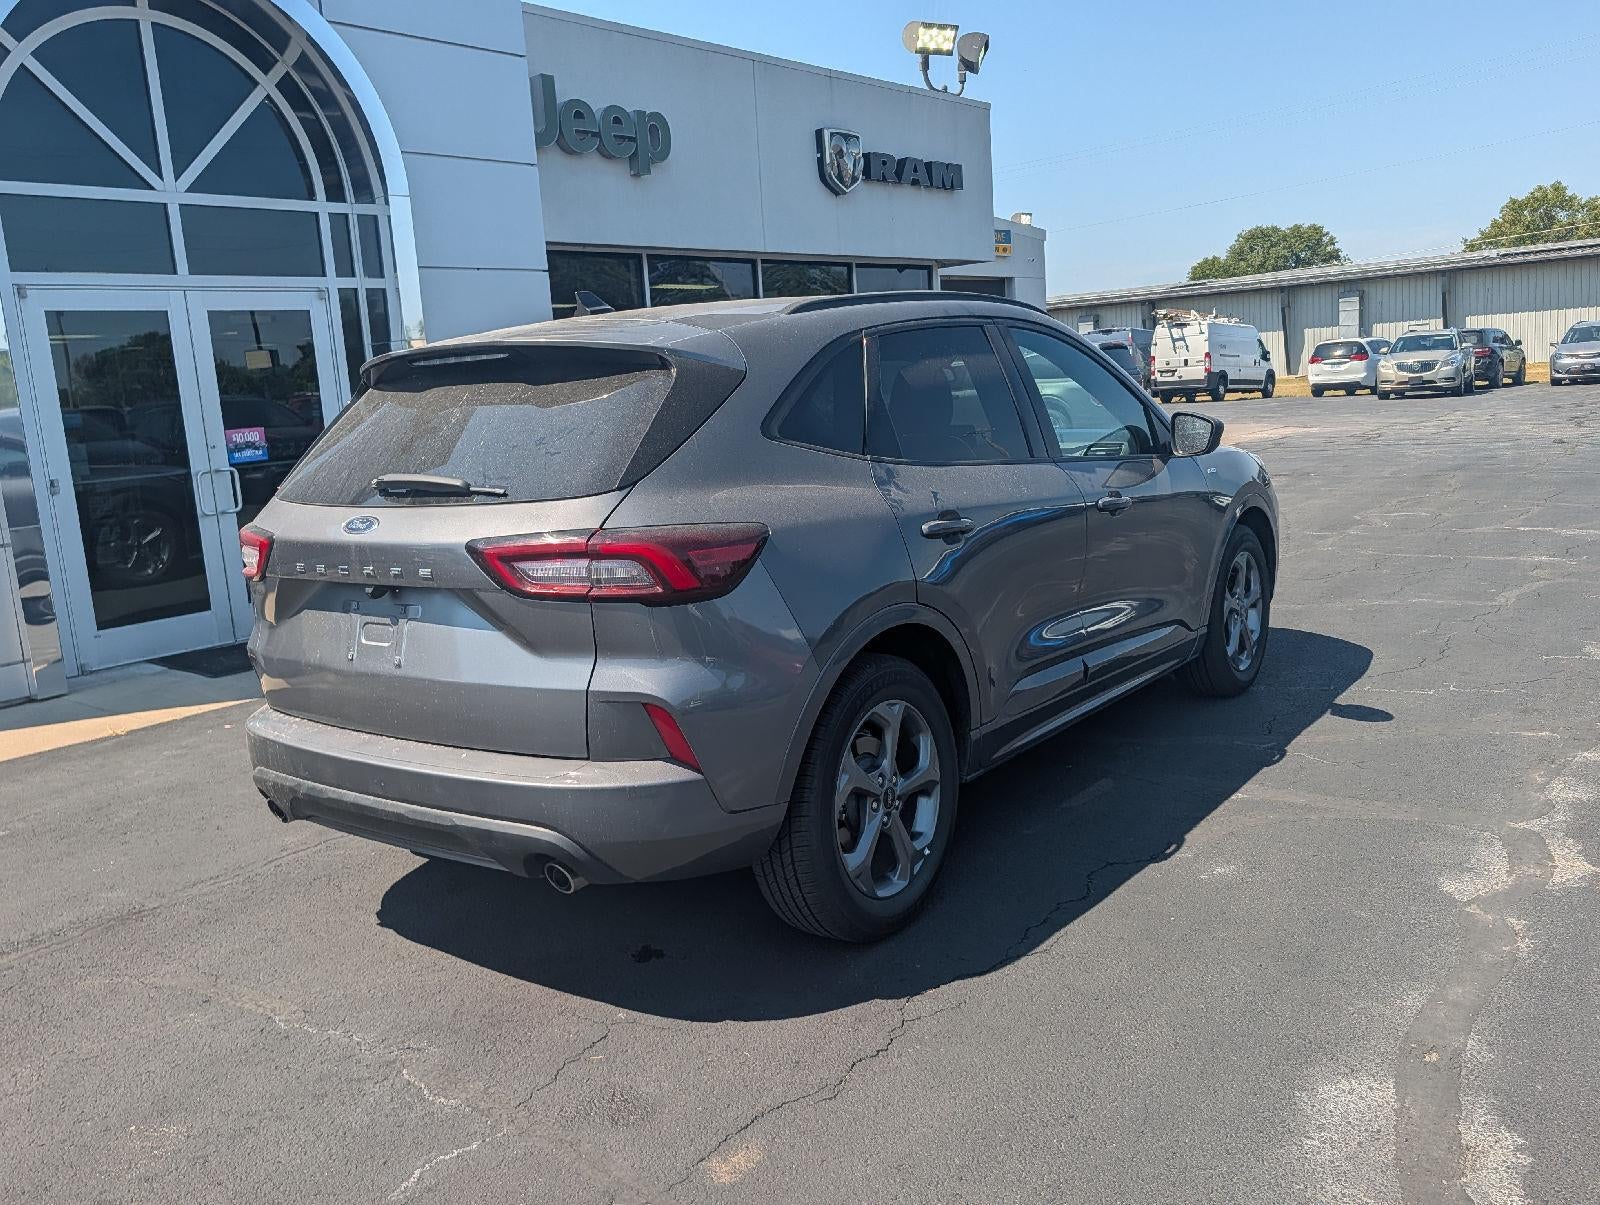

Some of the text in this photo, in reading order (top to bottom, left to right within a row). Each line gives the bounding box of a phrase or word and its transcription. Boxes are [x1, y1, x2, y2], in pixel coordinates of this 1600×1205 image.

[530, 73, 671, 176] Jeep
[864, 152, 964, 190] RAM
[346, 518, 374, 531] Ford
[296, 563, 432, 578] ESCAPE
